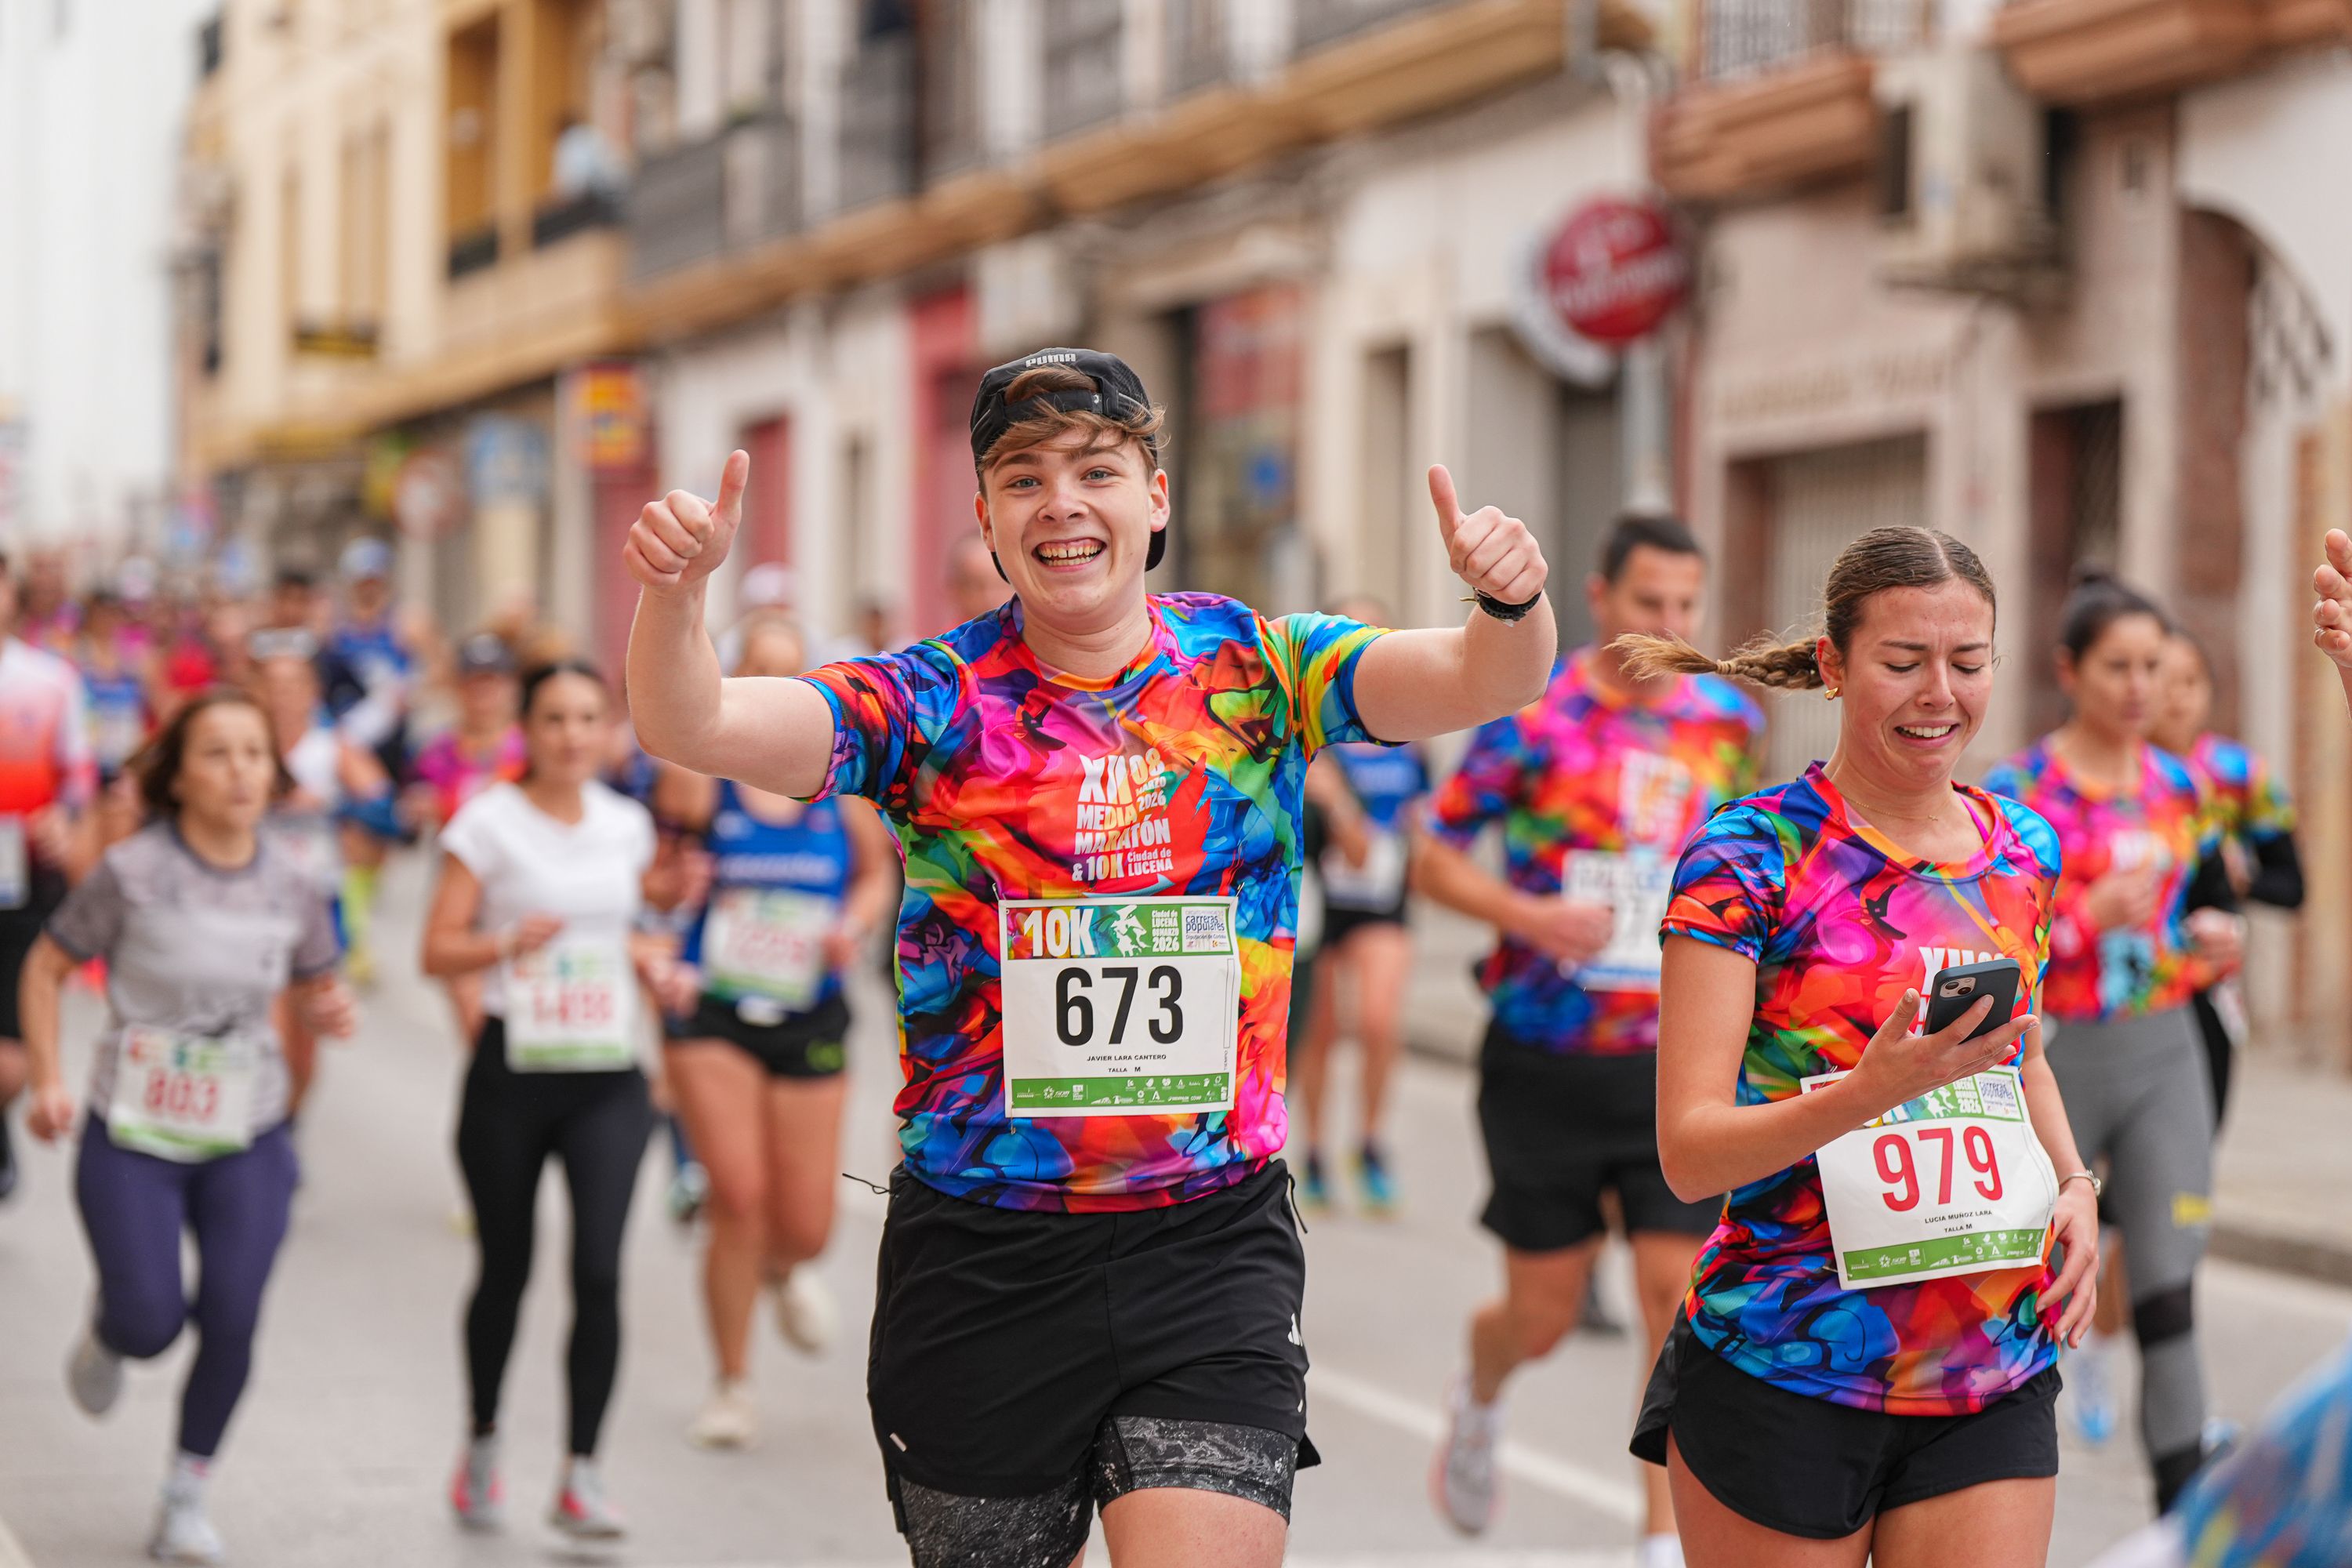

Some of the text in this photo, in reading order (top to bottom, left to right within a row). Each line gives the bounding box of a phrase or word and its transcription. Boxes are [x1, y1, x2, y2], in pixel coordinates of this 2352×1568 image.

[1025, 353, 1076, 368] PUMA
[1129, 747, 1166, 785] 08
[1077, 753, 1133, 805] XII
[1136, 776, 1167, 797] MARZO
[1138, 790, 1167, 812] 2026
[1076, 804, 1138, 831] MEDIA
[1074, 814, 1171, 855] MARATÓN
[1072, 852, 1125, 882] & 10K
[1127, 847, 1172, 863] Ciudad de
[1127, 858, 1174, 877] LUCENA
[1152, 917, 1178, 927] LUCENA
[1185, 915, 1218, 924] carreras
[1185, 922, 1225, 933] populares
[1023, 908, 1097, 957] 10K
[1152, 936, 1180, 953] 2026
[1056, 965, 1183, 1046] 673
[143, 1067, 220, 1122] 803
[1873, 1126, 2002, 1212] 979
